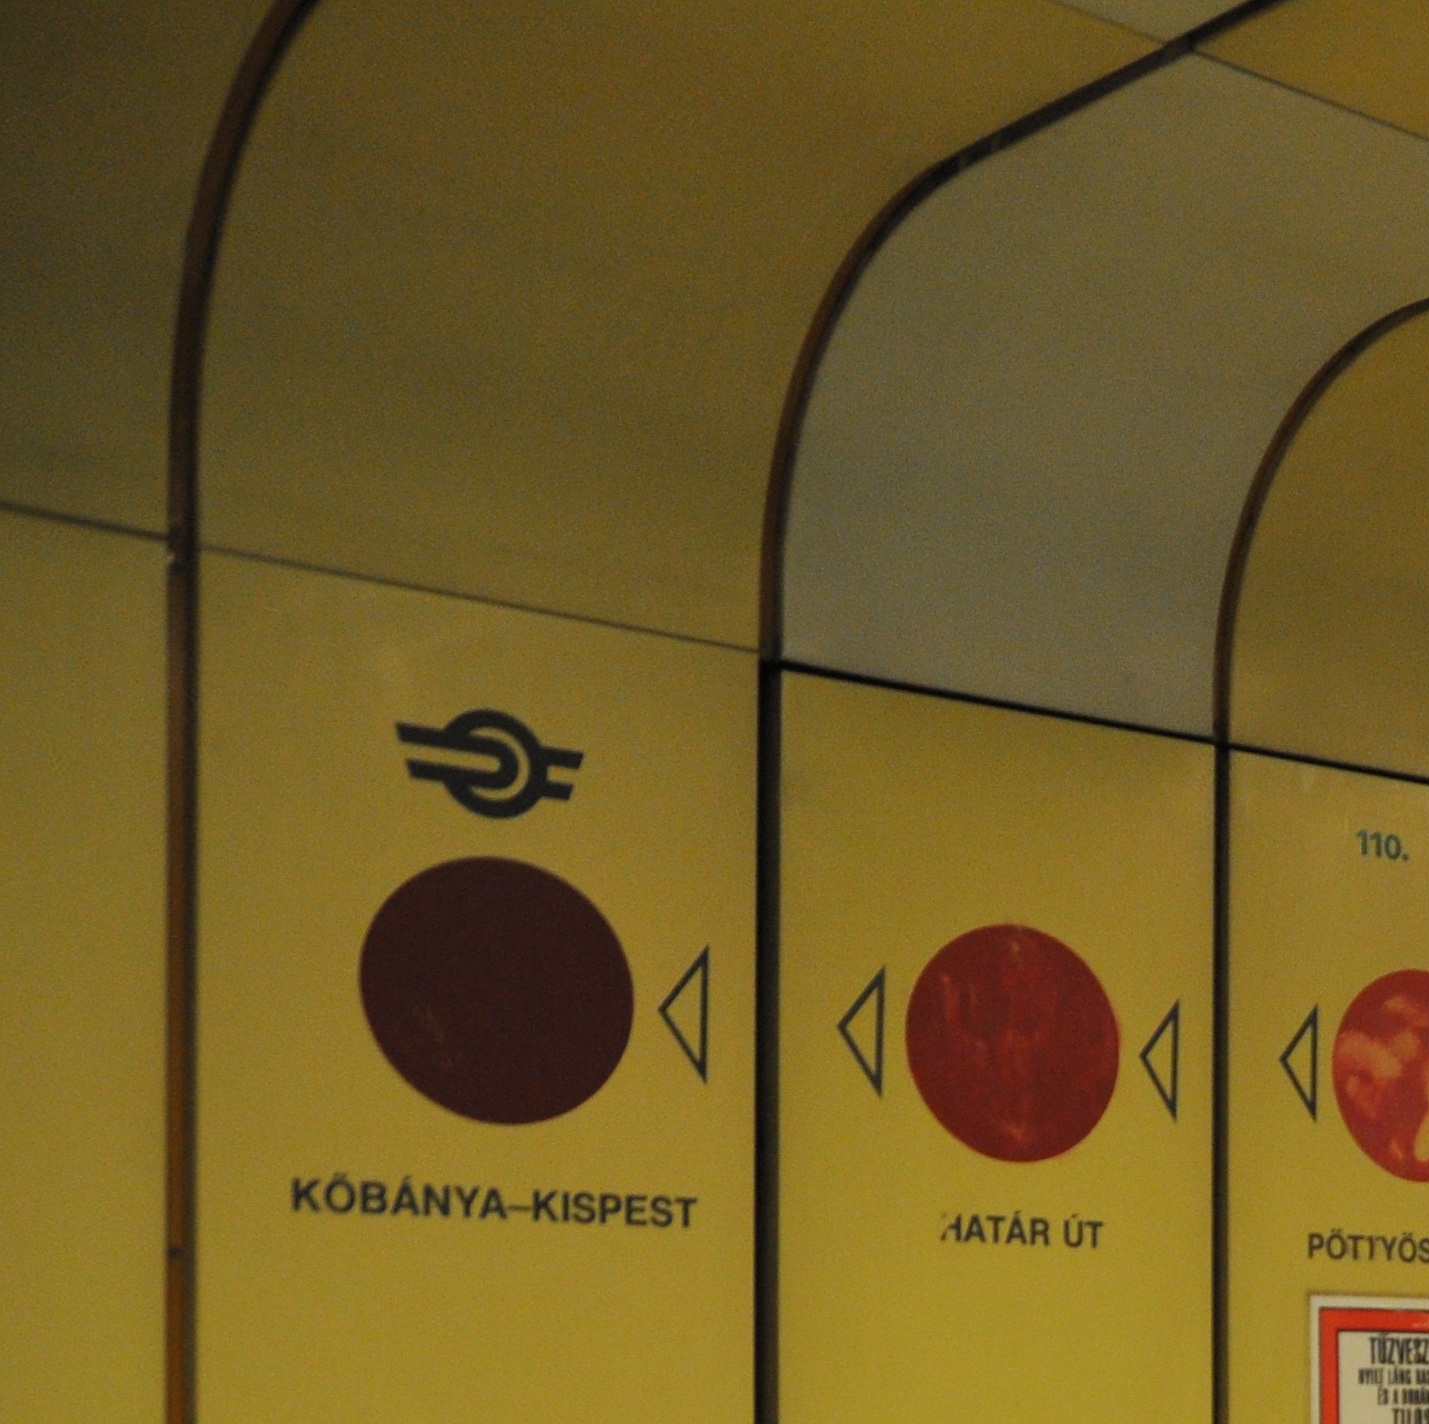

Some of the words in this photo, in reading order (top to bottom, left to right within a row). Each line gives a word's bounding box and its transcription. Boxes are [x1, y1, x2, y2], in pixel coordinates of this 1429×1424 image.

[1355, 829, 1409, 861] 110.
[940, 1210, 1050, 1246] HATÁR
[1063, 1213, 1104, 1248] ÚT
